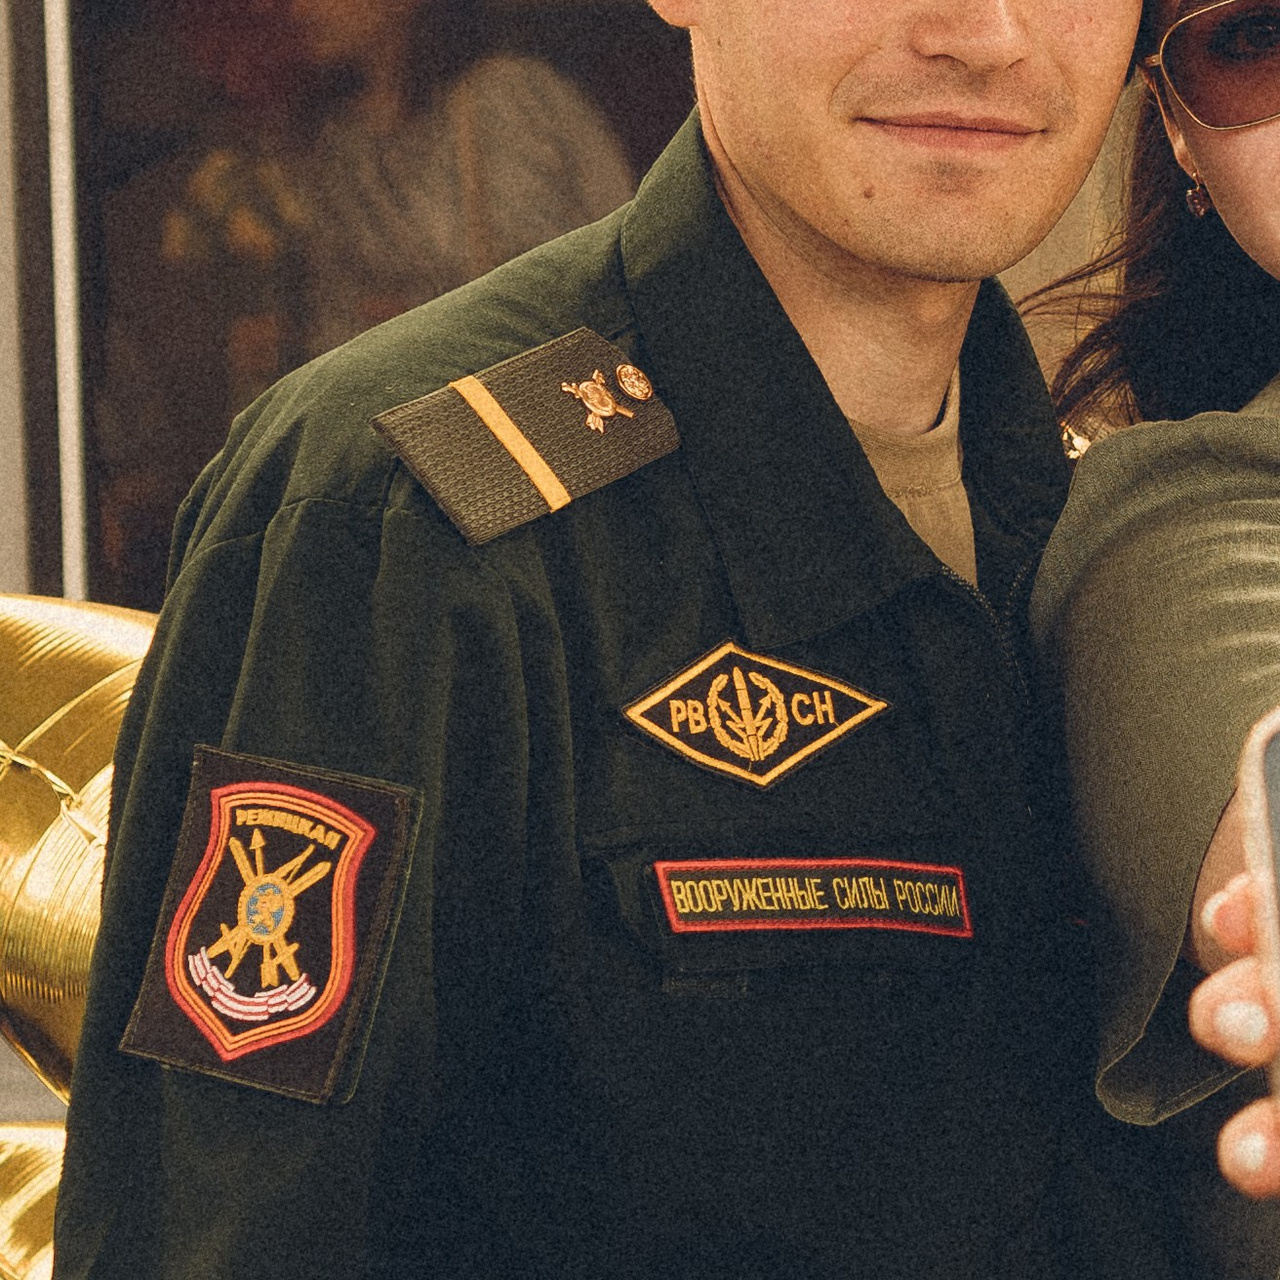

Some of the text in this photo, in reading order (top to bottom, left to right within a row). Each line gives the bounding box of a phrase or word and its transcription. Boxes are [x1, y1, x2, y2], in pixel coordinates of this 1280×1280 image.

[669, 690, 836, 734] РВ СН
[671, 876, 960, 918] ВООРУЖЕННЫЕ СИЛЫ РОССИИ
